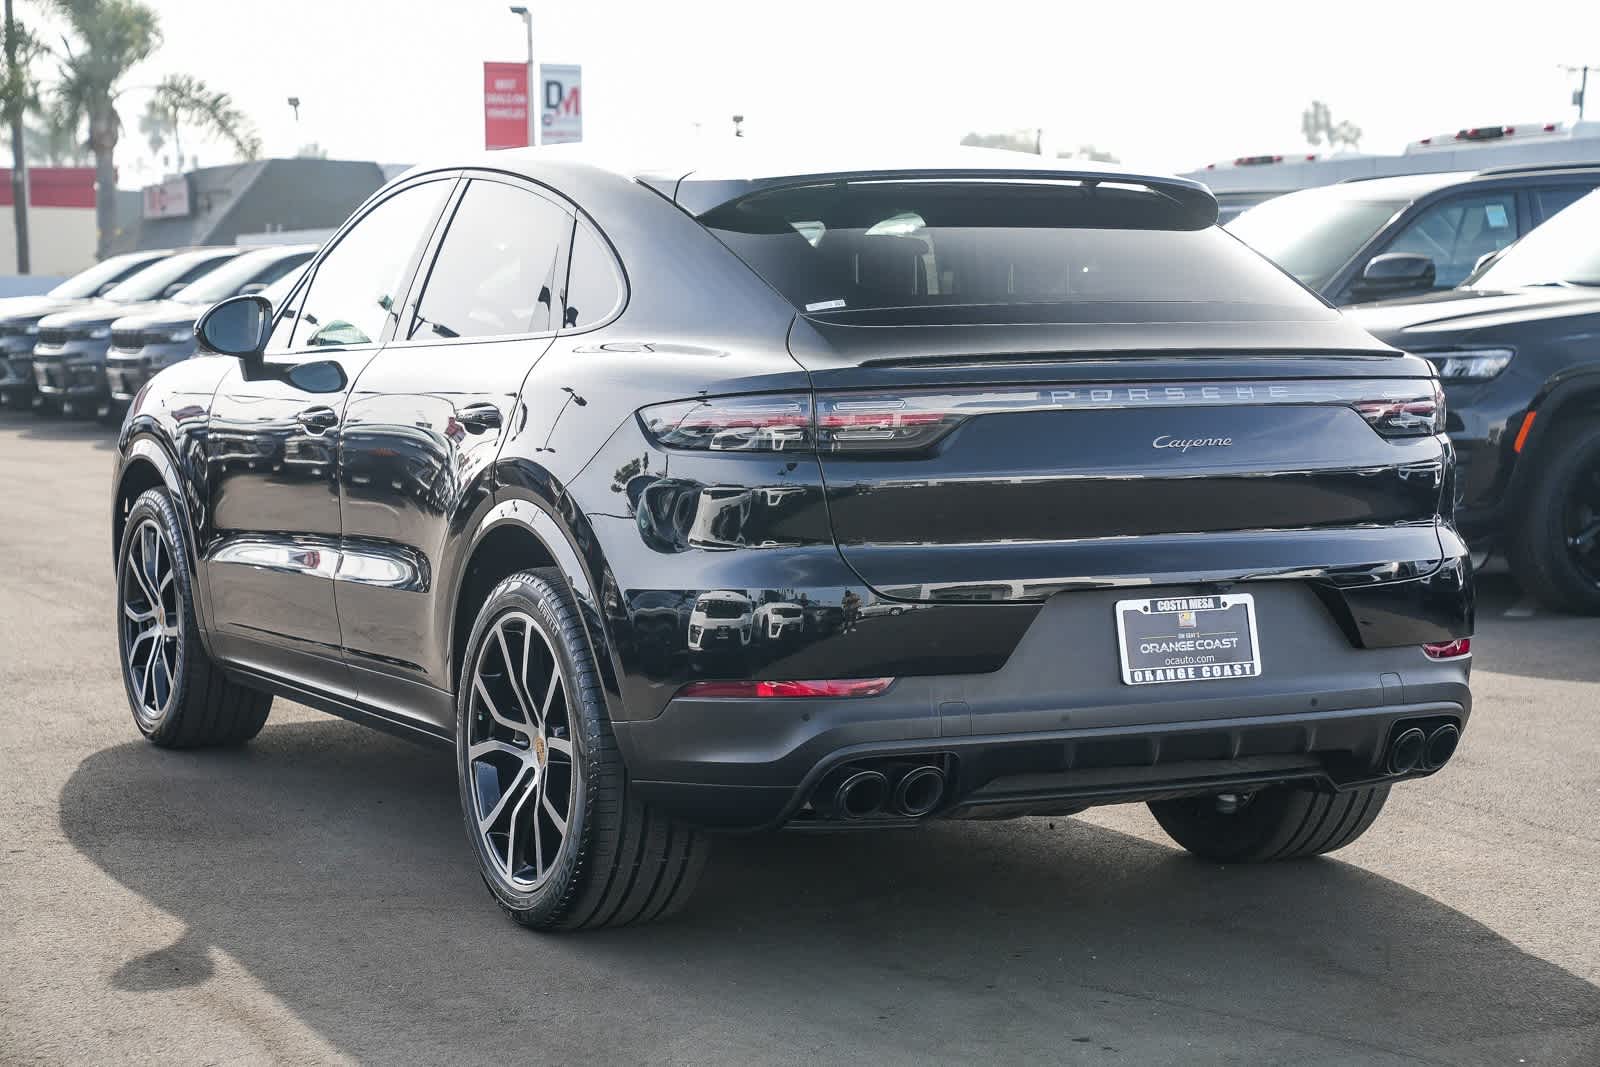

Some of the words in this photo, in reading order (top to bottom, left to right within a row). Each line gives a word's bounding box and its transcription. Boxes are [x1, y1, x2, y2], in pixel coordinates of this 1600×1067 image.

[1050, 386, 1288, 403] PORSCHE
[1152, 435, 1233, 452] Cayenne
[1157, 599, 1188, 612] COSTA
[1189, 598, 1215, 610] MESA
[1140, 641, 1195, 654] ORANGE
[1195, 638, 1239, 650] COAST
[1165, 655, 1215, 666] ocauto.com
[1133, 667, 1195, 682] ORANGE
[1202, 663, 1253, 678] COAST
